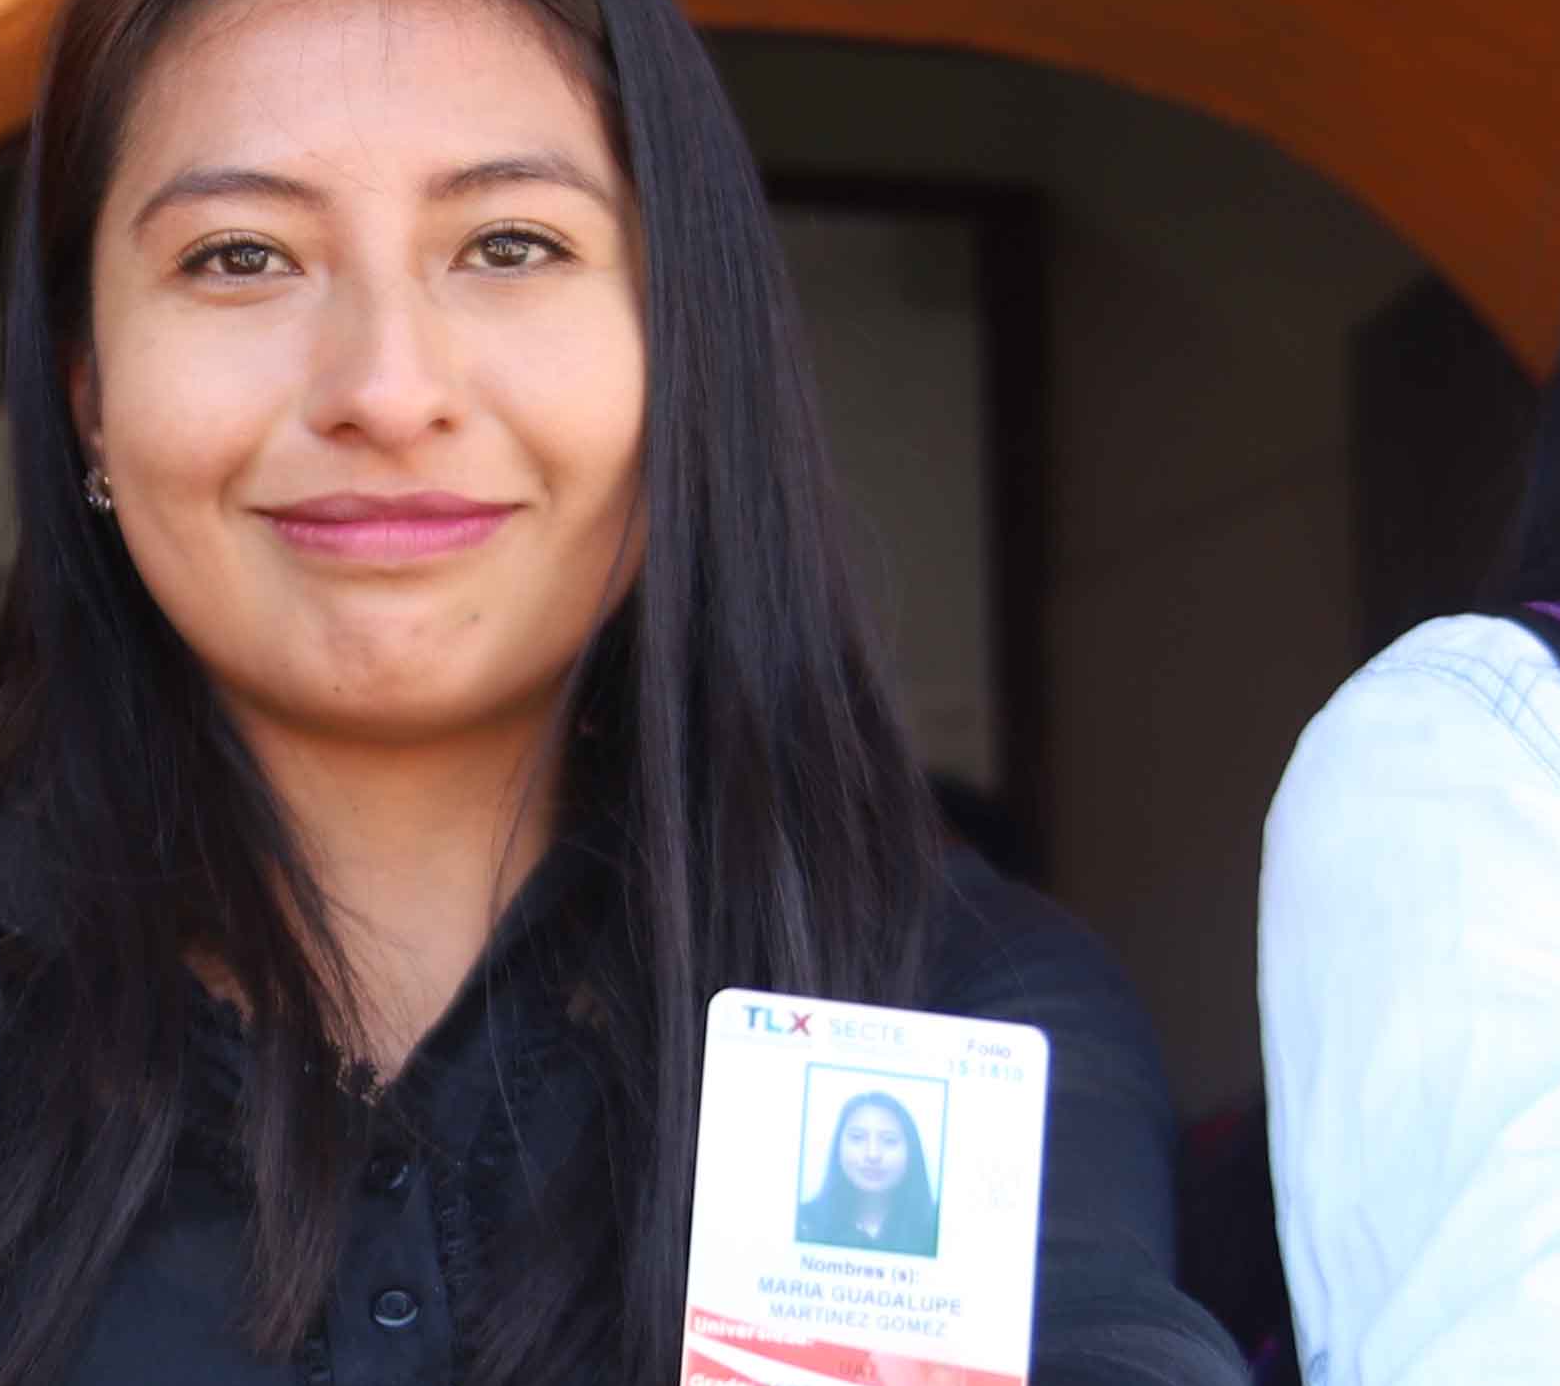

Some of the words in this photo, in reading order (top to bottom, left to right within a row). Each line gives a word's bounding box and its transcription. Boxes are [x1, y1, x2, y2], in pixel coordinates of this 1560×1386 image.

[741, 1004, 813, 1037] TLX
[828, 1016, 905, 1045] SECTE
[966, 1038, 1013, 1060] Folio
[801, 1256, 885, 1280] Nombres
[758, 1277, 823, 1299] MARIA
[831, 1285, 961, 1317] GUADALUPE
[769, 1302, 870, 1329] MARTINEZ
[876, 1315, 948, 1340] GOMEZ
